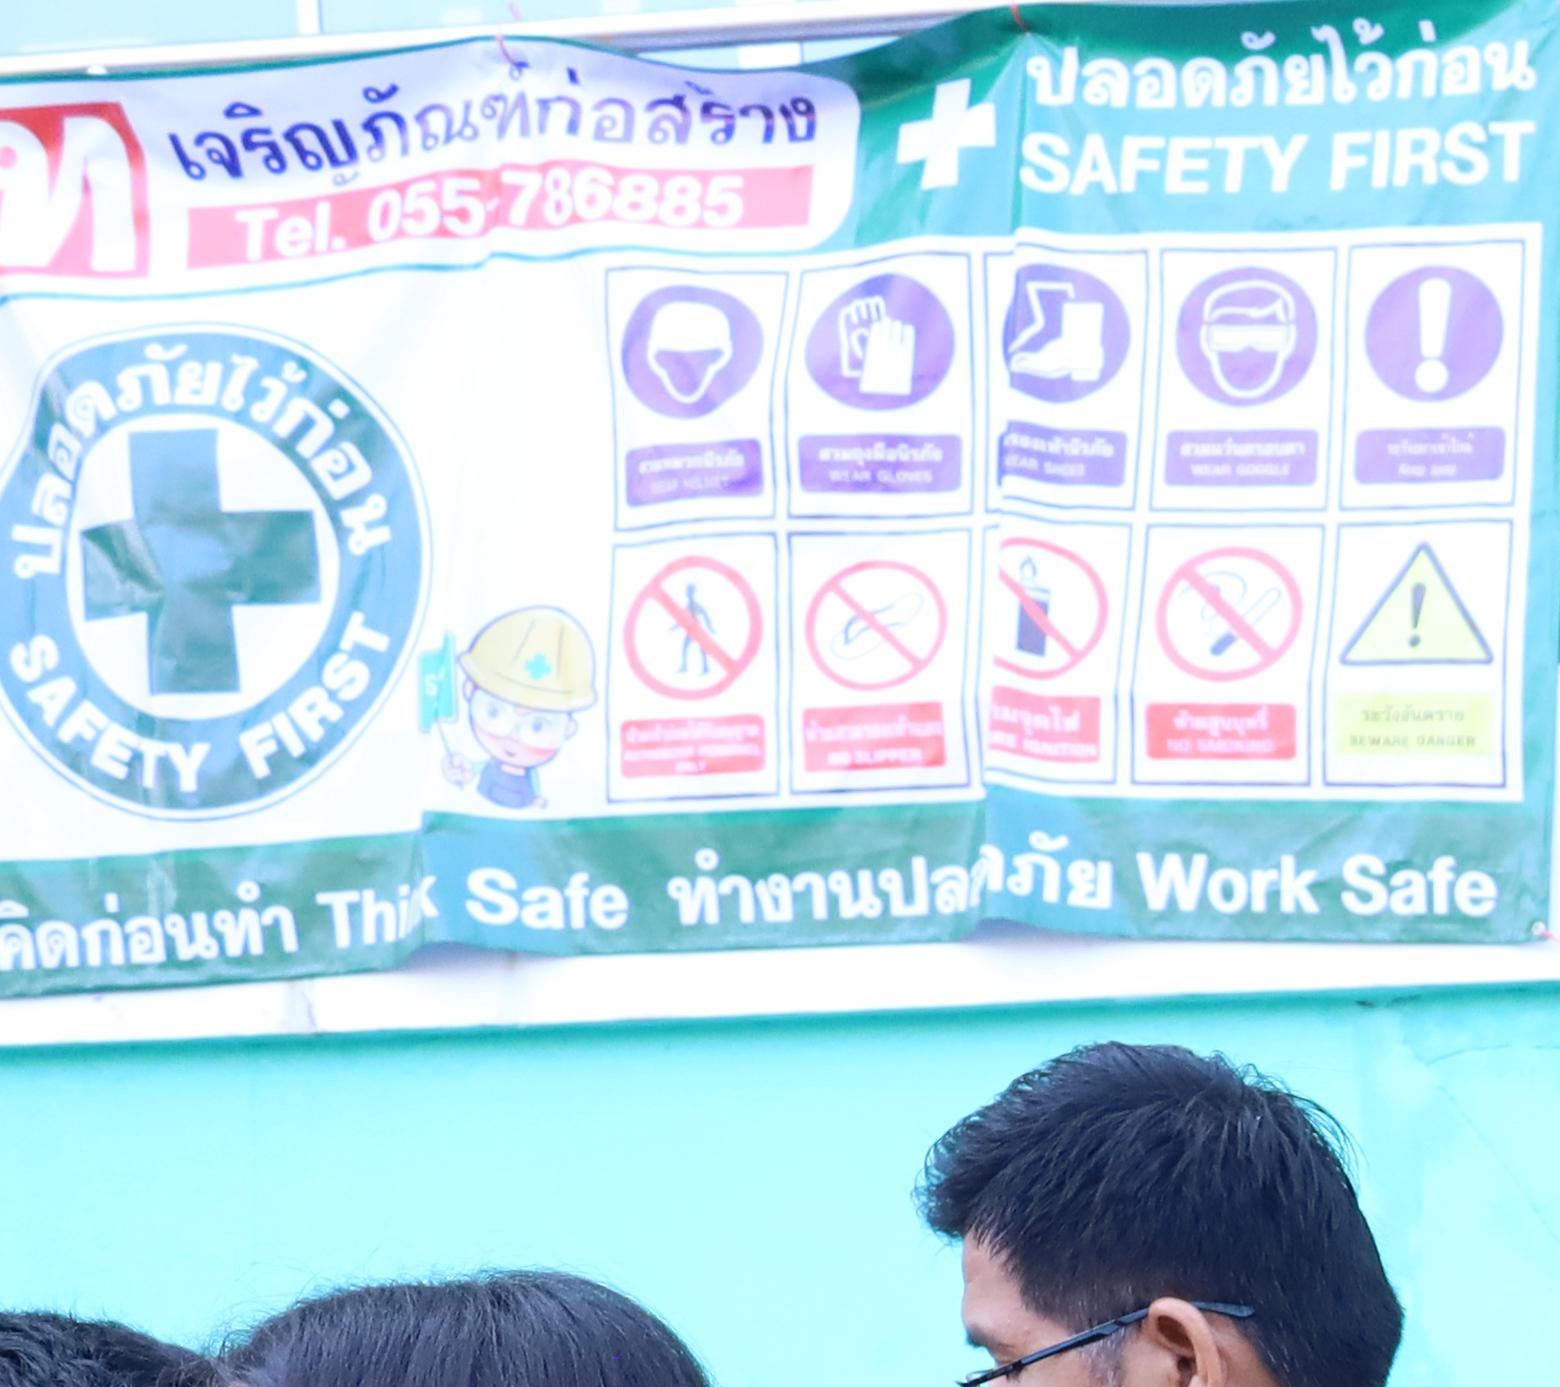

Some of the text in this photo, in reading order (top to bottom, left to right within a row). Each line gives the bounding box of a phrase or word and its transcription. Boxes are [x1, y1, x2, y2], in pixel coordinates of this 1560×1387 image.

[1026, 20, 1537, 109] ปลอดภัยไว้ก่อน
[169, 62, 818, 188] เจริญภัณฑ์ก่อสร้าง
[1019, 121, 1537, 196] SAFETY FIRST
[235, 208, 347, 261] Tel.
[10, 610, 390, 792] SAFETY FIRST
[1350, 733, 1477, 749] BEWARE DANGER
[0, 880, 298, 971] คิดก่อนทำ
[316, 874, 438, 949] Thik
[466, 867, 630, 931] Safe
[1135, 850, 1320, 915] Work
[1341, 852, 1499, 917] Safe
